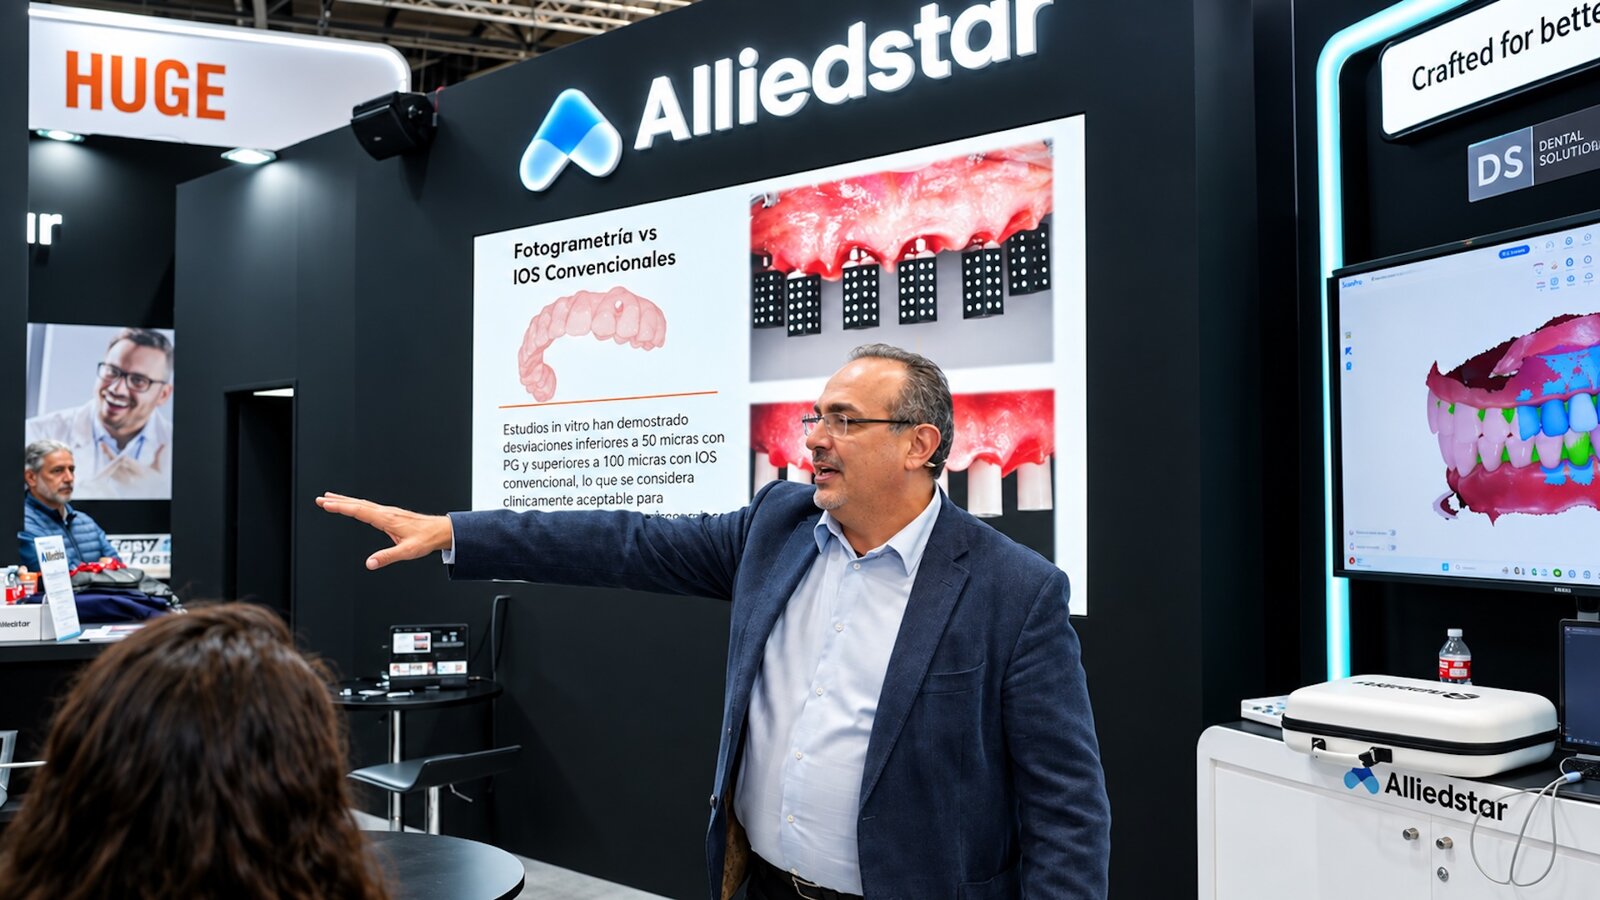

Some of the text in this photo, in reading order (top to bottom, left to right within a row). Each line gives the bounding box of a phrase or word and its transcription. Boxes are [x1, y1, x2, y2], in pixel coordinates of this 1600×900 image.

[634, 0, 1053, 149] Alliedstar
[1412, 37, 1493, 91] Crafted
[1500, 30, 1534, 59] for
[66, 50, 226, 120] HUGE
[1539, 130, 1584, 152] DENTAL
[1478, 145, 1524, 187] DS
[514, 227, 657, 259] Fotogrametría vs
[513, 251, 676, 285] IOS Convencionales
[503, 413, 689, 436] Estudios in vitro han demostrado
[503, 433, 725, 454] desviaciones inferiores a 50 micras con
[503, 450, 717, 474] PG y superiores a 100 micras con IOS
[503, 471, 694, 489] convencional, lo que se considera
[576, 492, 634, 508] aceptable
[637, 494, 663, 507] para
[1385, 772, 1508, 821] Alliedstar
